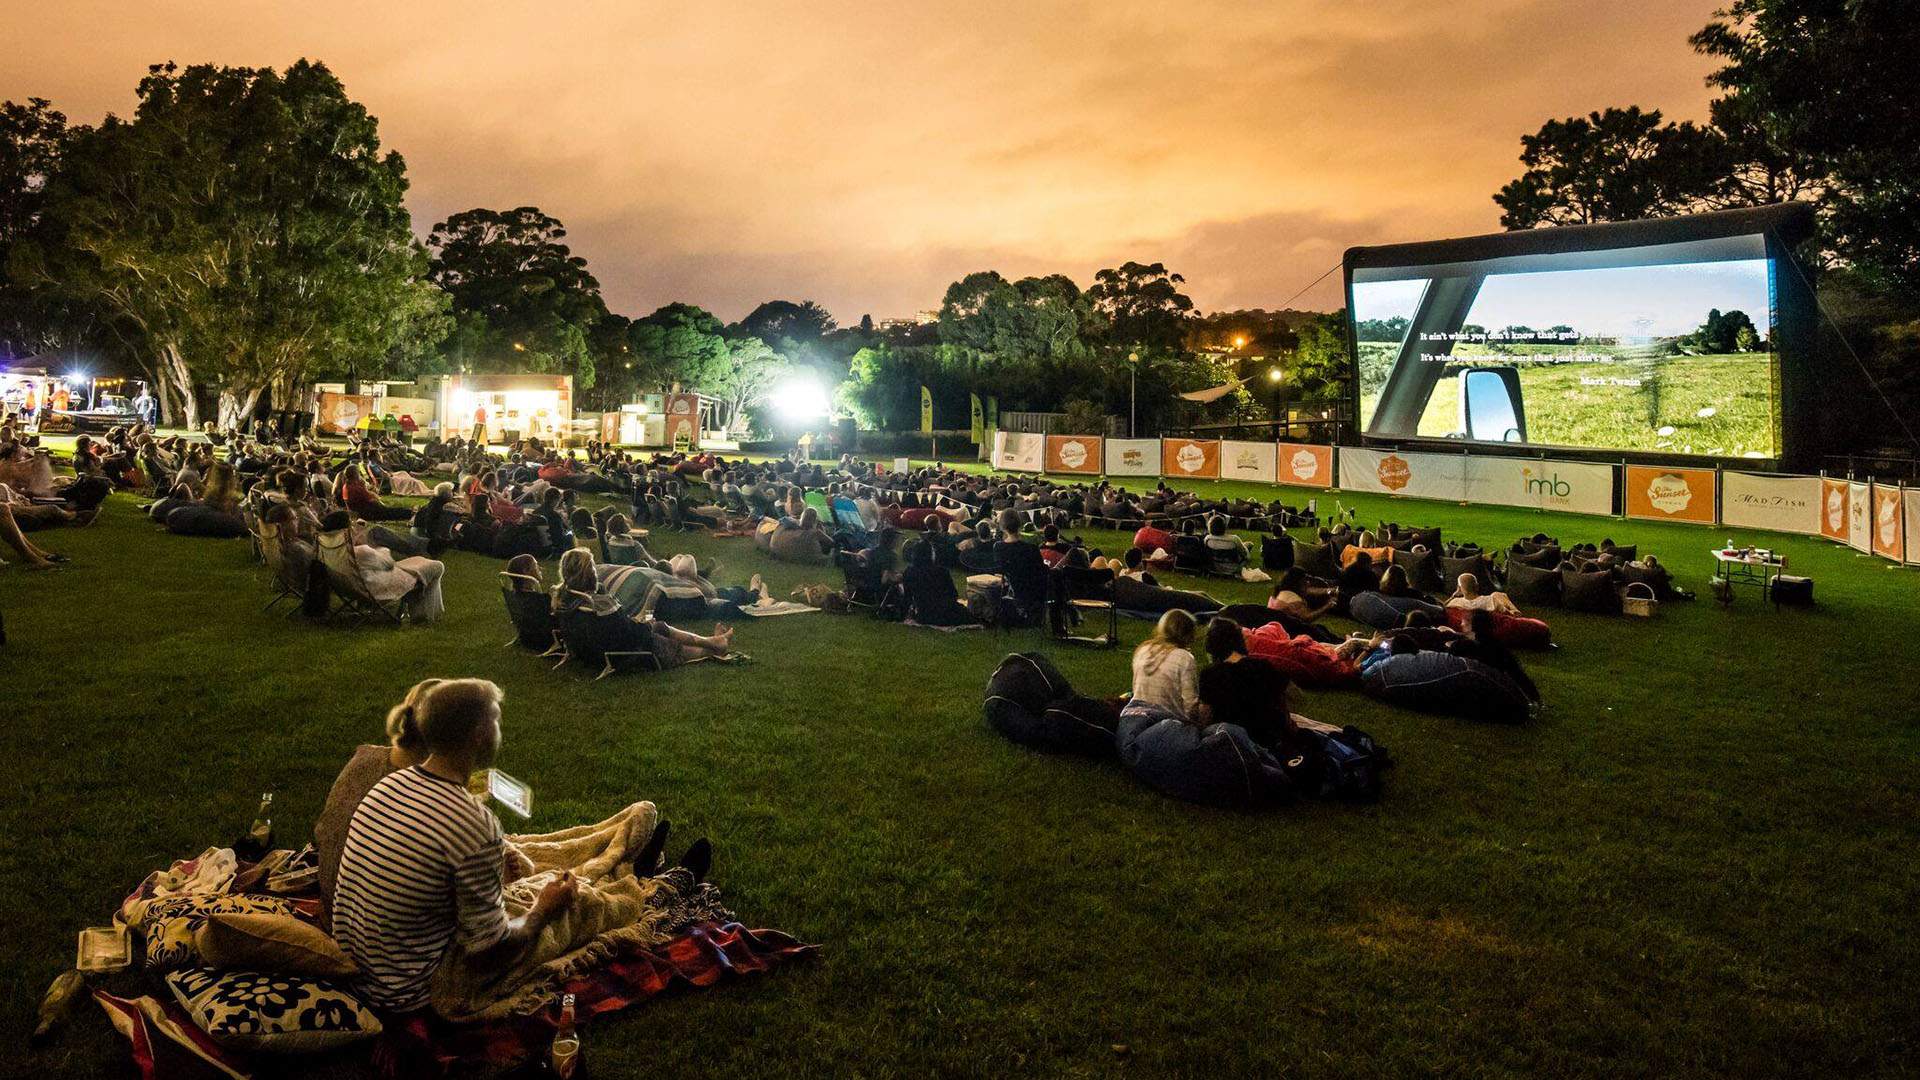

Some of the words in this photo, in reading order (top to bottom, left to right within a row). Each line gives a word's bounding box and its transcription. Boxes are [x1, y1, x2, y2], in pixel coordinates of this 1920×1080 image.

[1420, 332, 1427, 340] It
[1429, 332, 1447, 340] ain't
[1449, 332, 1470, 340] what
[1470, 333, 1486, 343] you
[1488, 331, 1510, 340] don't
[1537, 331, 1557, 339] that
[1420, 353, 1433, 361] It's
[1435, 353, 1455, 361] what
[1522, 468, 1571, 497] imb
[1651, 486, 1689, 499] Sunset
